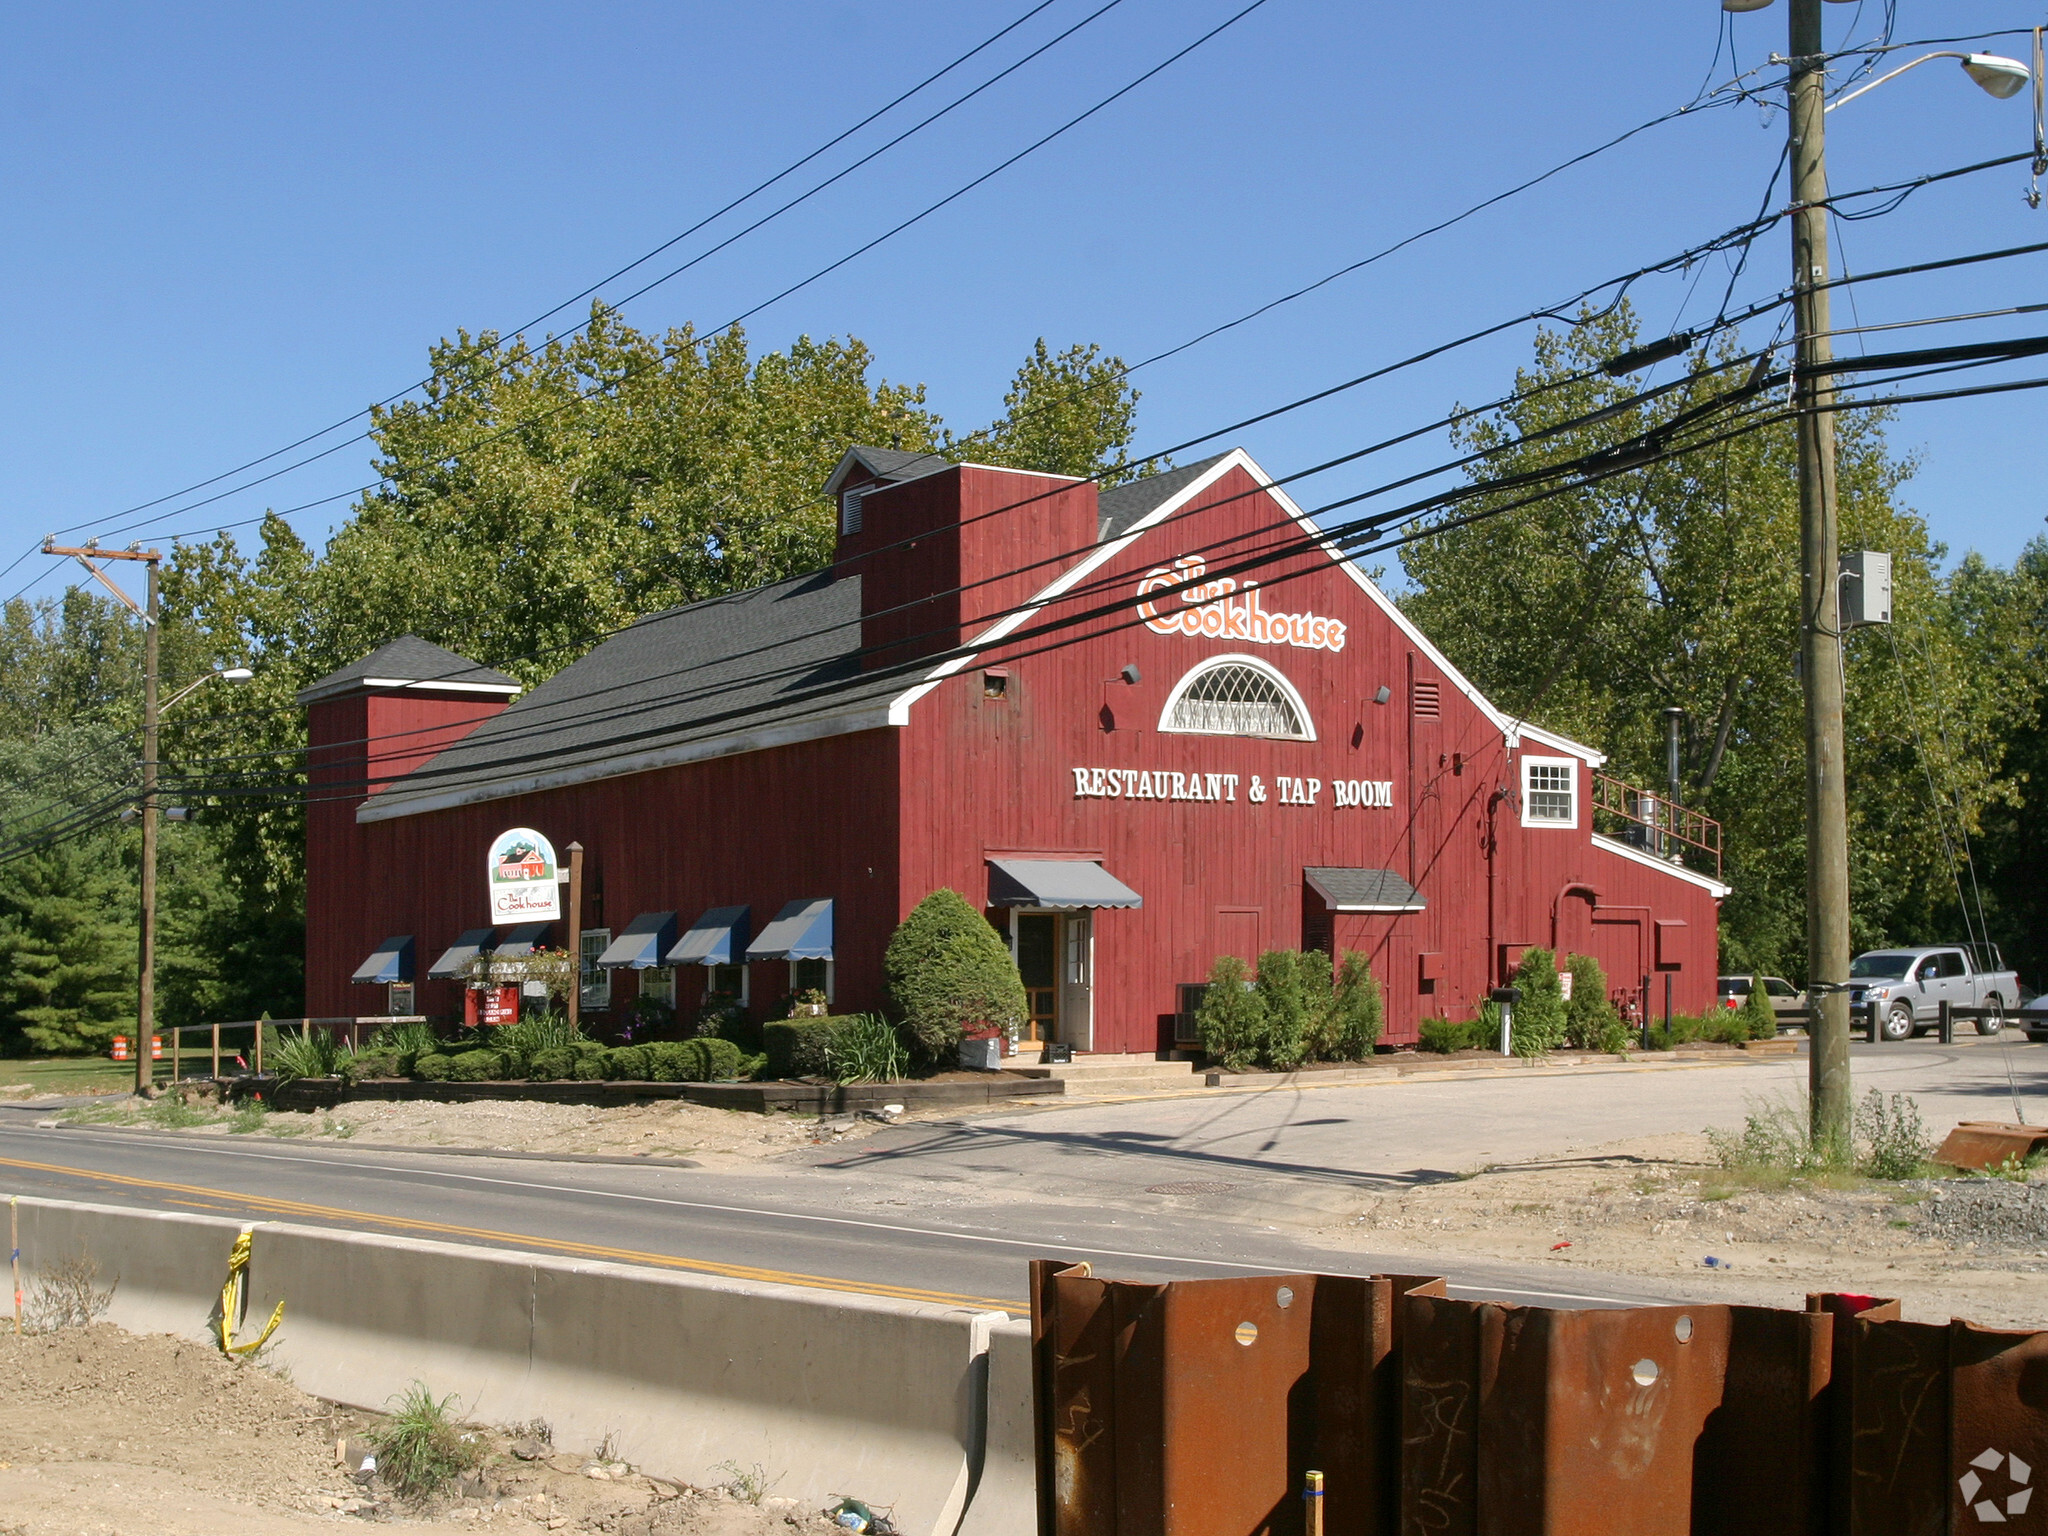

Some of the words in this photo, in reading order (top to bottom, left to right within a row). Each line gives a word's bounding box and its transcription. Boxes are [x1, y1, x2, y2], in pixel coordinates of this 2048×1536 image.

[1176, 556, 1220, 601] The
[1138, 570, 1346, 651] Cookhouse
[1072, 767, 1239, 801] RESTAURANT
[1249, 775, 1267, 803] &
[1277, 776, 1322, 805] TAP
[1333, 780, 1393, 808] ROOM
[507, 893, 518, 902] The
